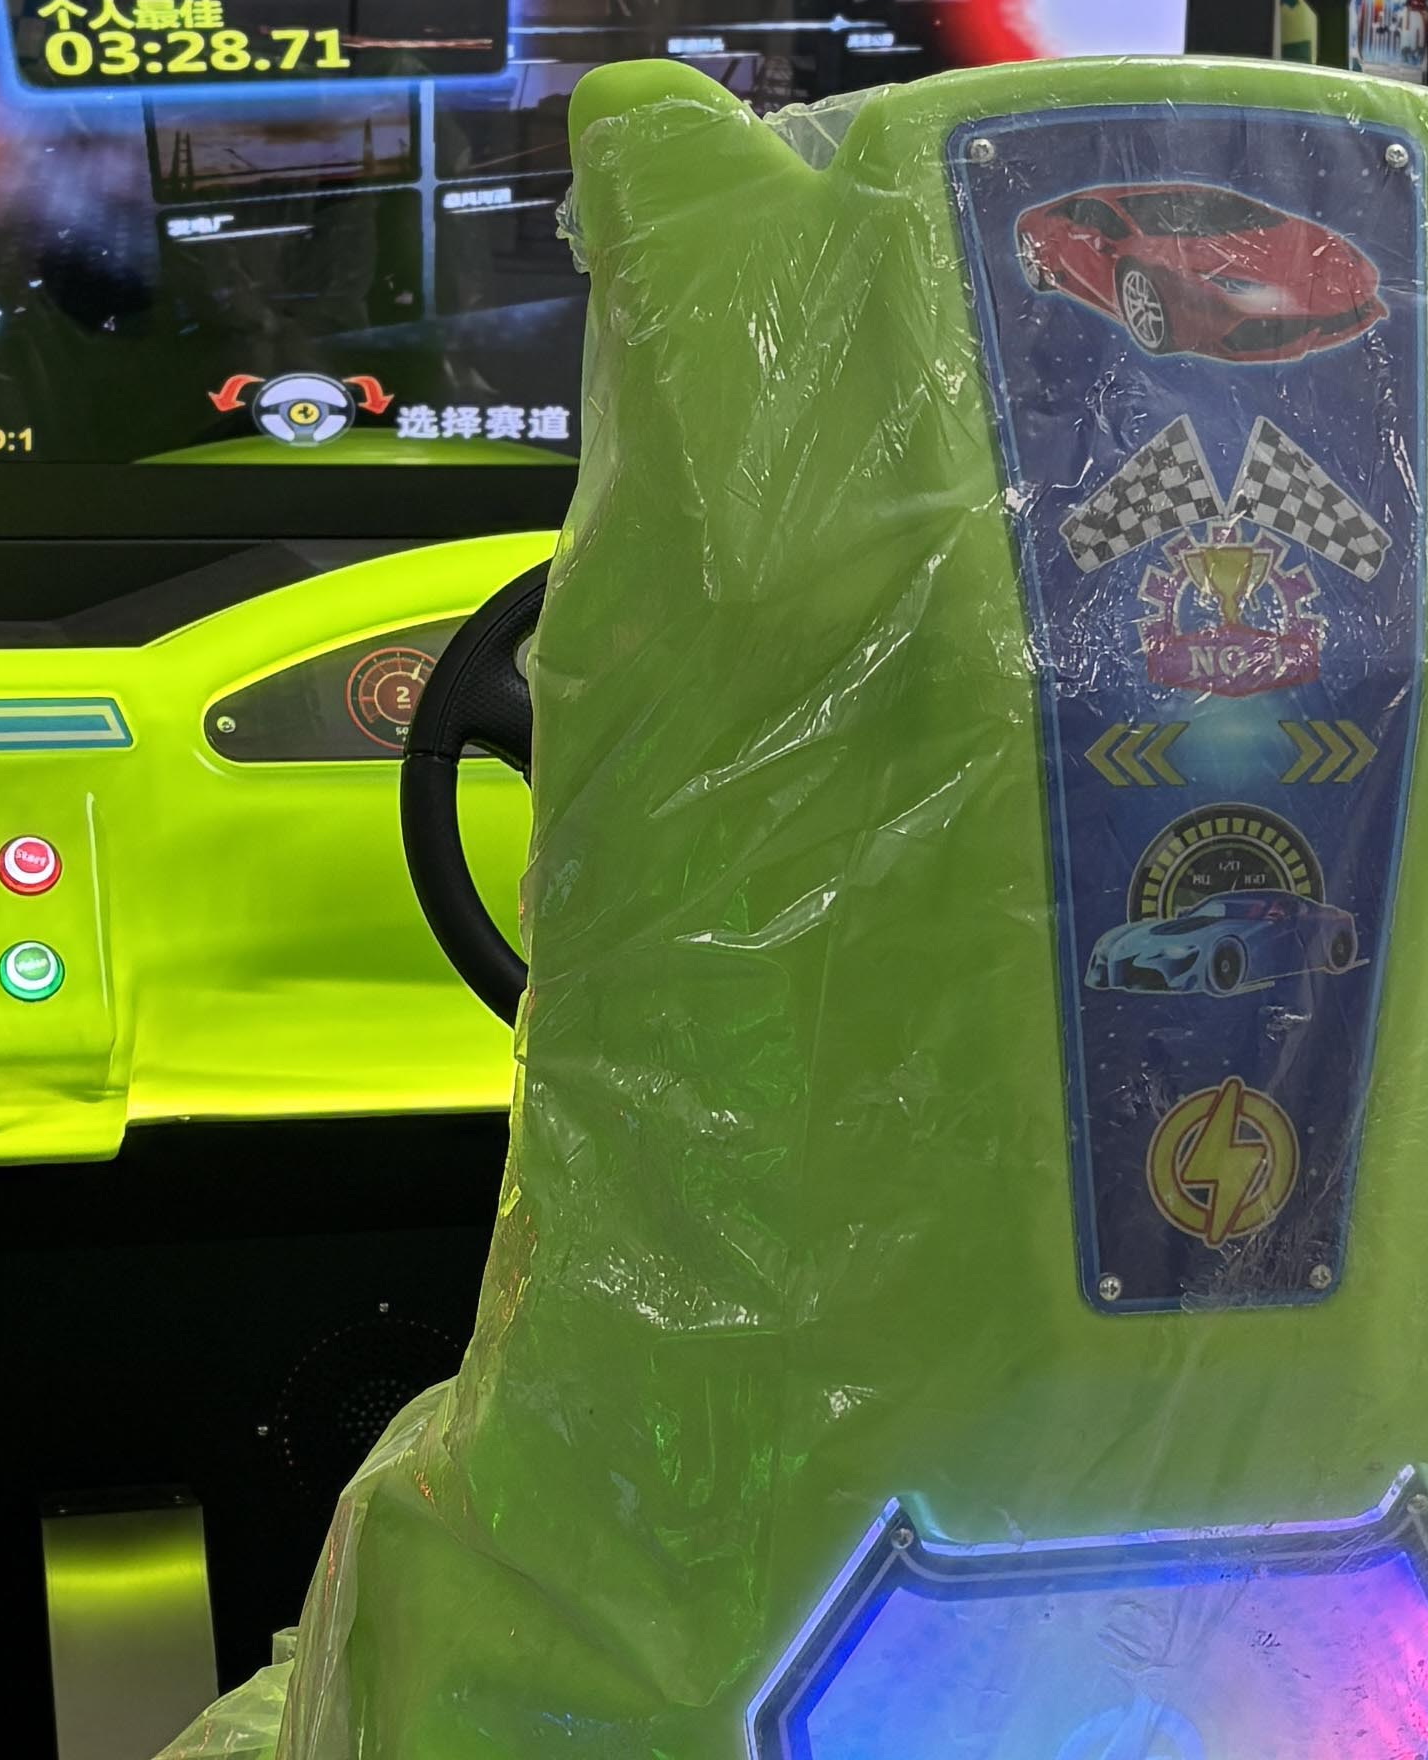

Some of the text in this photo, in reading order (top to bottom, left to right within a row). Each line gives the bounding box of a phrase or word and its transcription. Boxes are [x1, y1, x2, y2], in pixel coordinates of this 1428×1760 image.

[44, 28, 351, 76] 03:28.71
[396, 405, 571, 439] 选择赛道
[395, 686, 412, 703] 2
